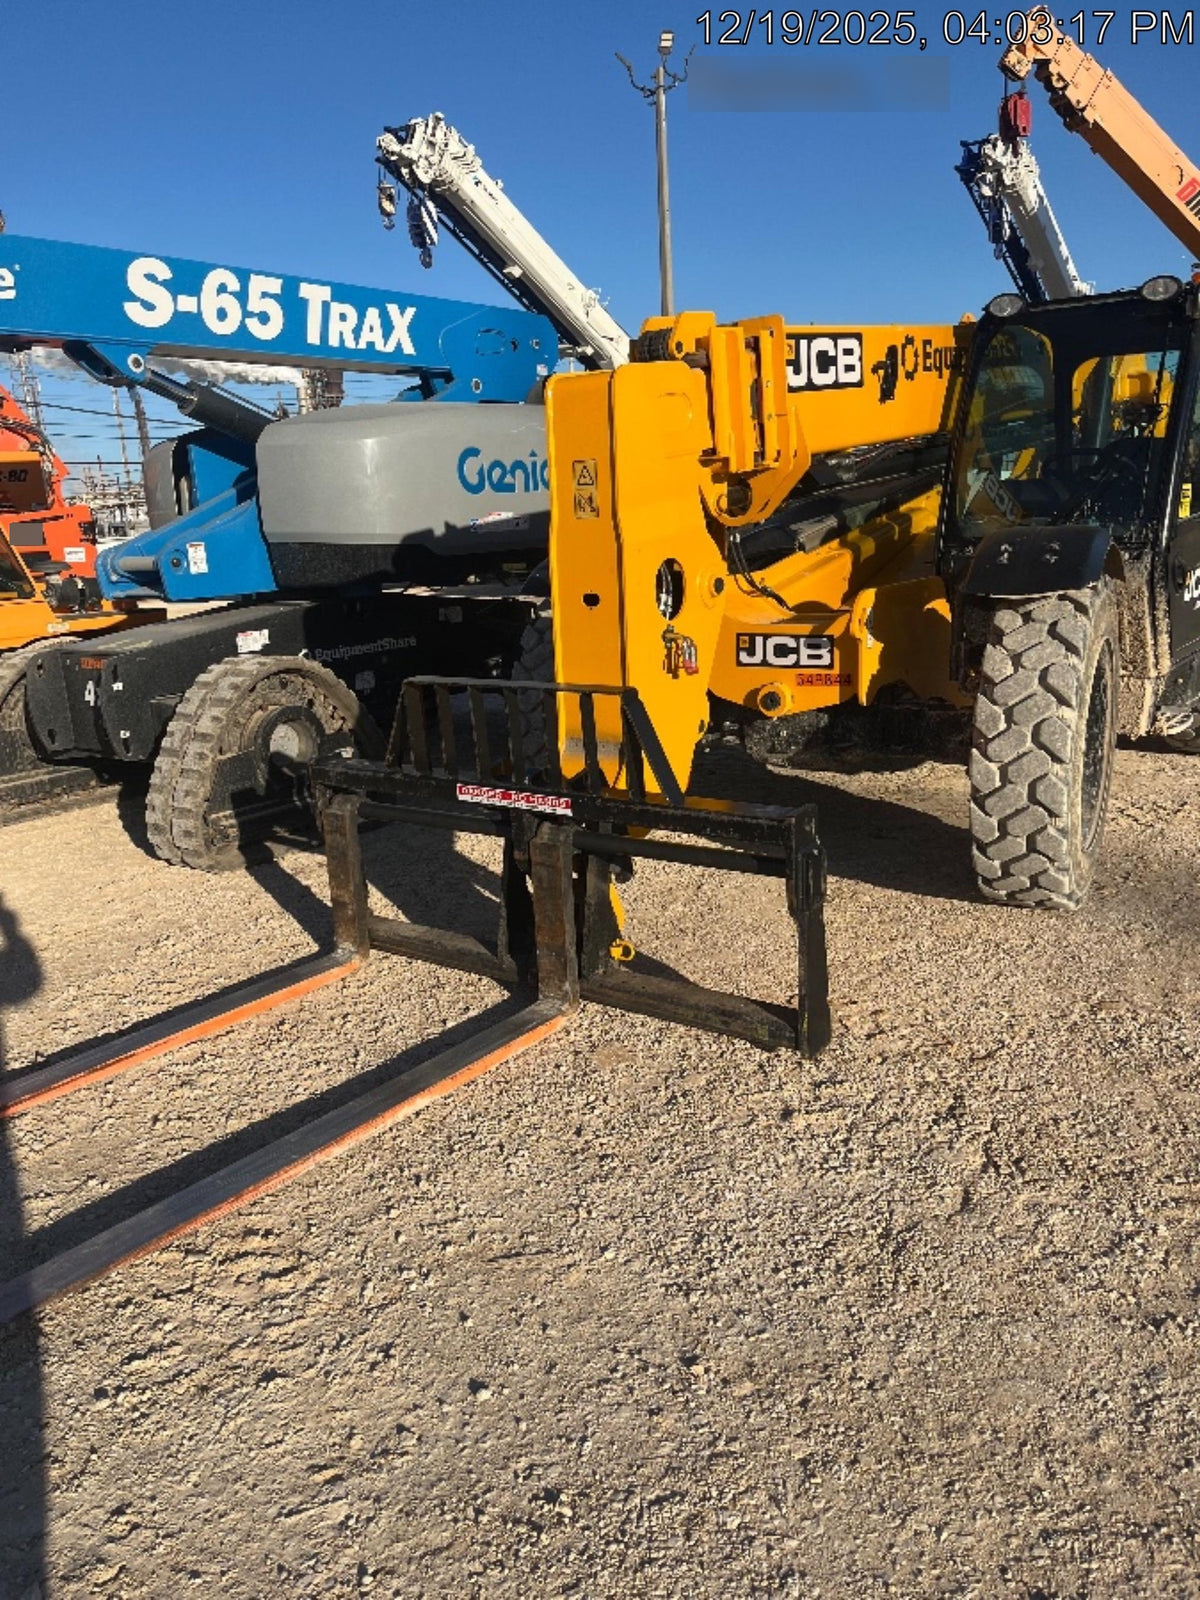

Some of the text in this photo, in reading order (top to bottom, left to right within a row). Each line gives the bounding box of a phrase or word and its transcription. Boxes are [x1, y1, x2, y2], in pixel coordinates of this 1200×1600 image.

[123, 256, 417, 356] S-65 TRAX
[785, 337, 862, 388] JCB
[315, 636, 417, 662] EquipmentShare
[738, 635, 832, 666] JCB
[84, 680, 95, 707] 4
